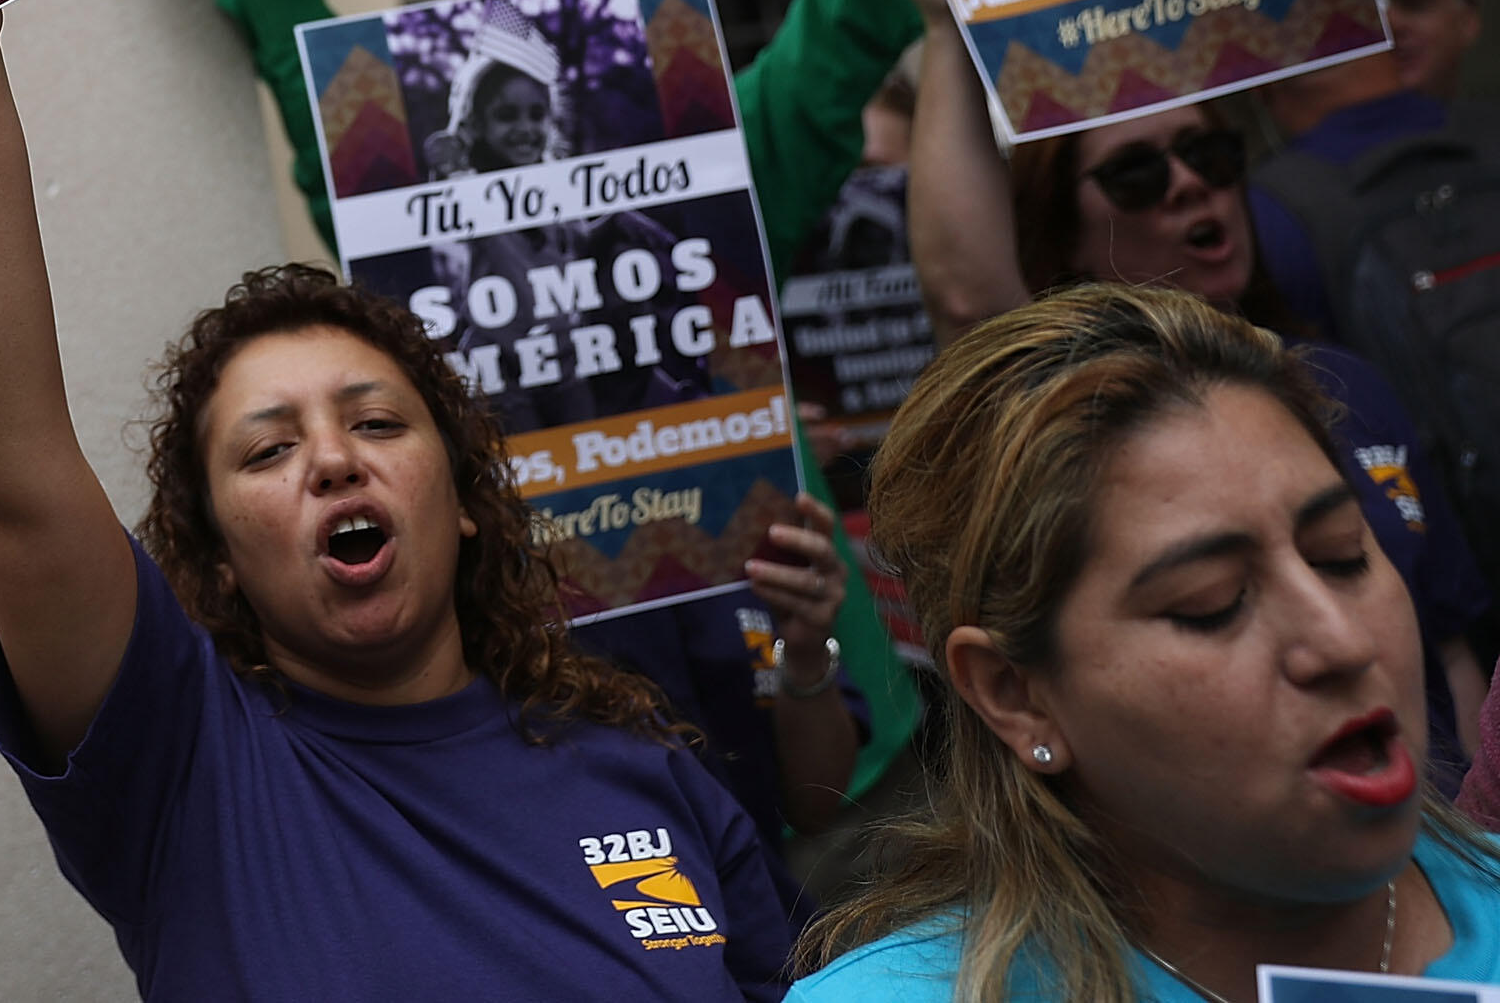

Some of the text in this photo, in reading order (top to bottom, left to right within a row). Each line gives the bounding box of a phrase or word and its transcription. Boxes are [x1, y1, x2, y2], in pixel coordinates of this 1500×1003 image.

[486, 175, 560, 221] Yo,
[570, 156, 690, 208] Todos
[409, 236, 716, 339] SOMOS
[434, 294, 776, 397] MÉRICA
[572, 395, 789, 473] Podemos!
[579, 828, 672, 865] 32BJ
[625, 907, 718, 938] SEIU
